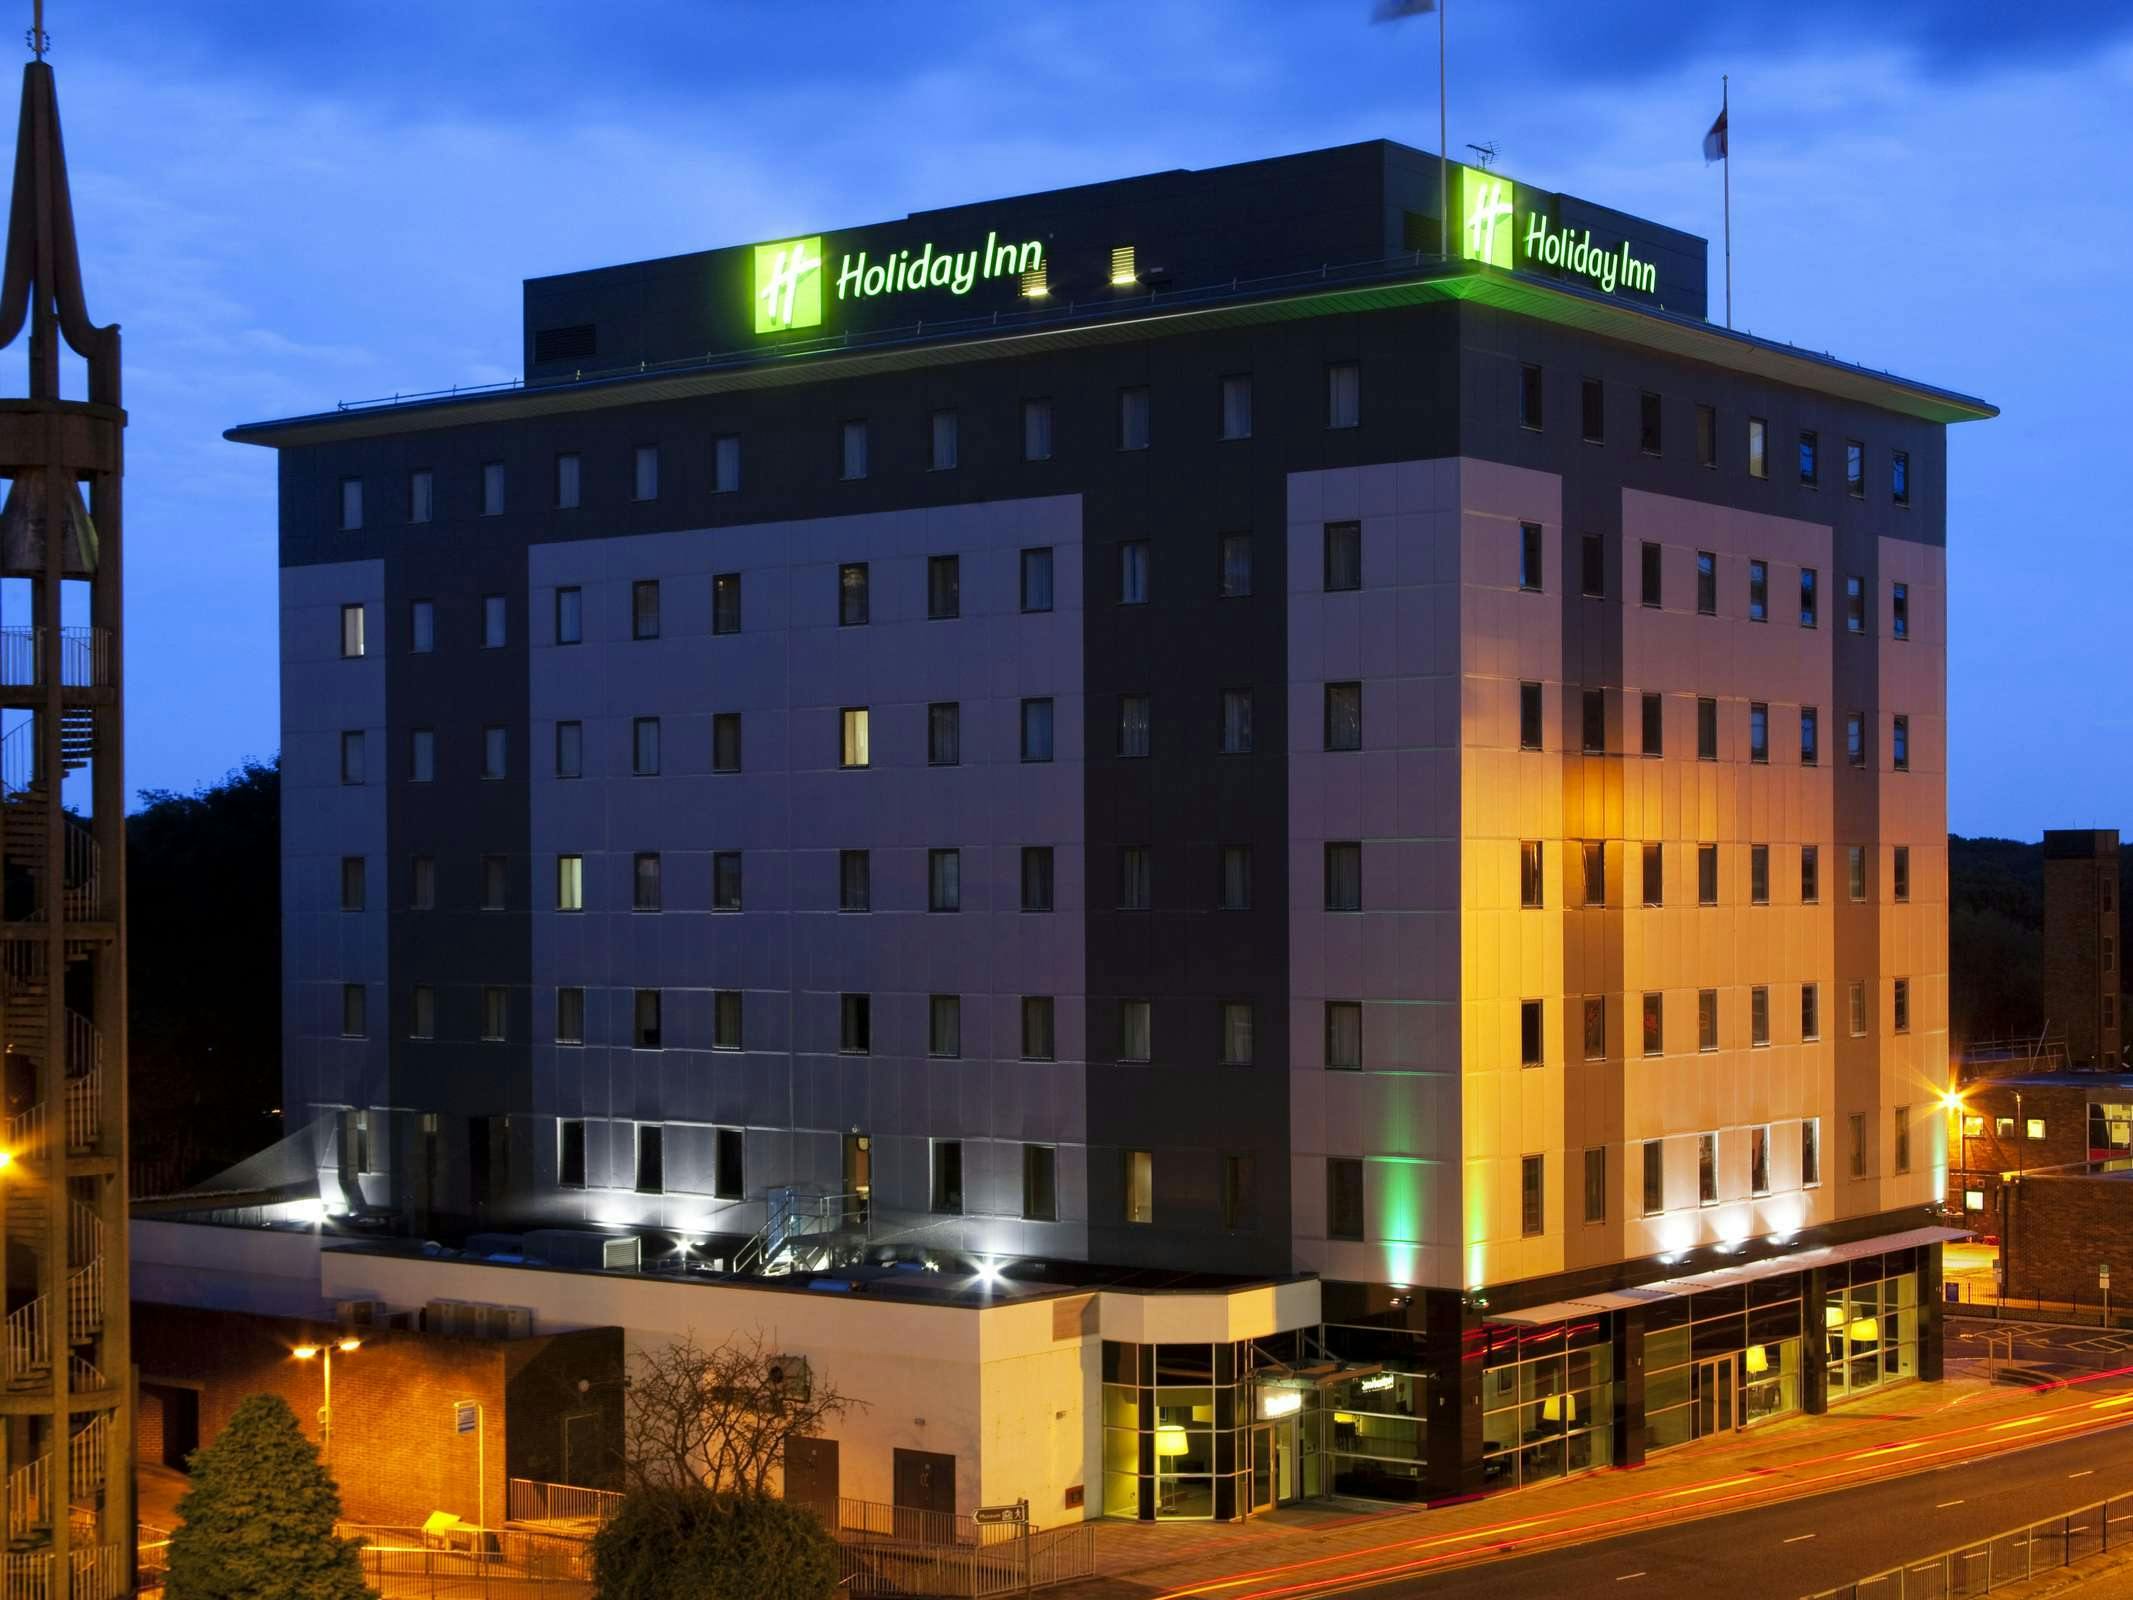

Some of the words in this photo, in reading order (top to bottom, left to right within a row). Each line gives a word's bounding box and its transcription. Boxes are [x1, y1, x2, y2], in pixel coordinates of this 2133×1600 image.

[836, 243, 977, 300] Holiday
[983, 231, 1042, 279] Inn
[1523, 211, 1618, 293] Holiday
[1621, 240, 1656, 294] Inn
